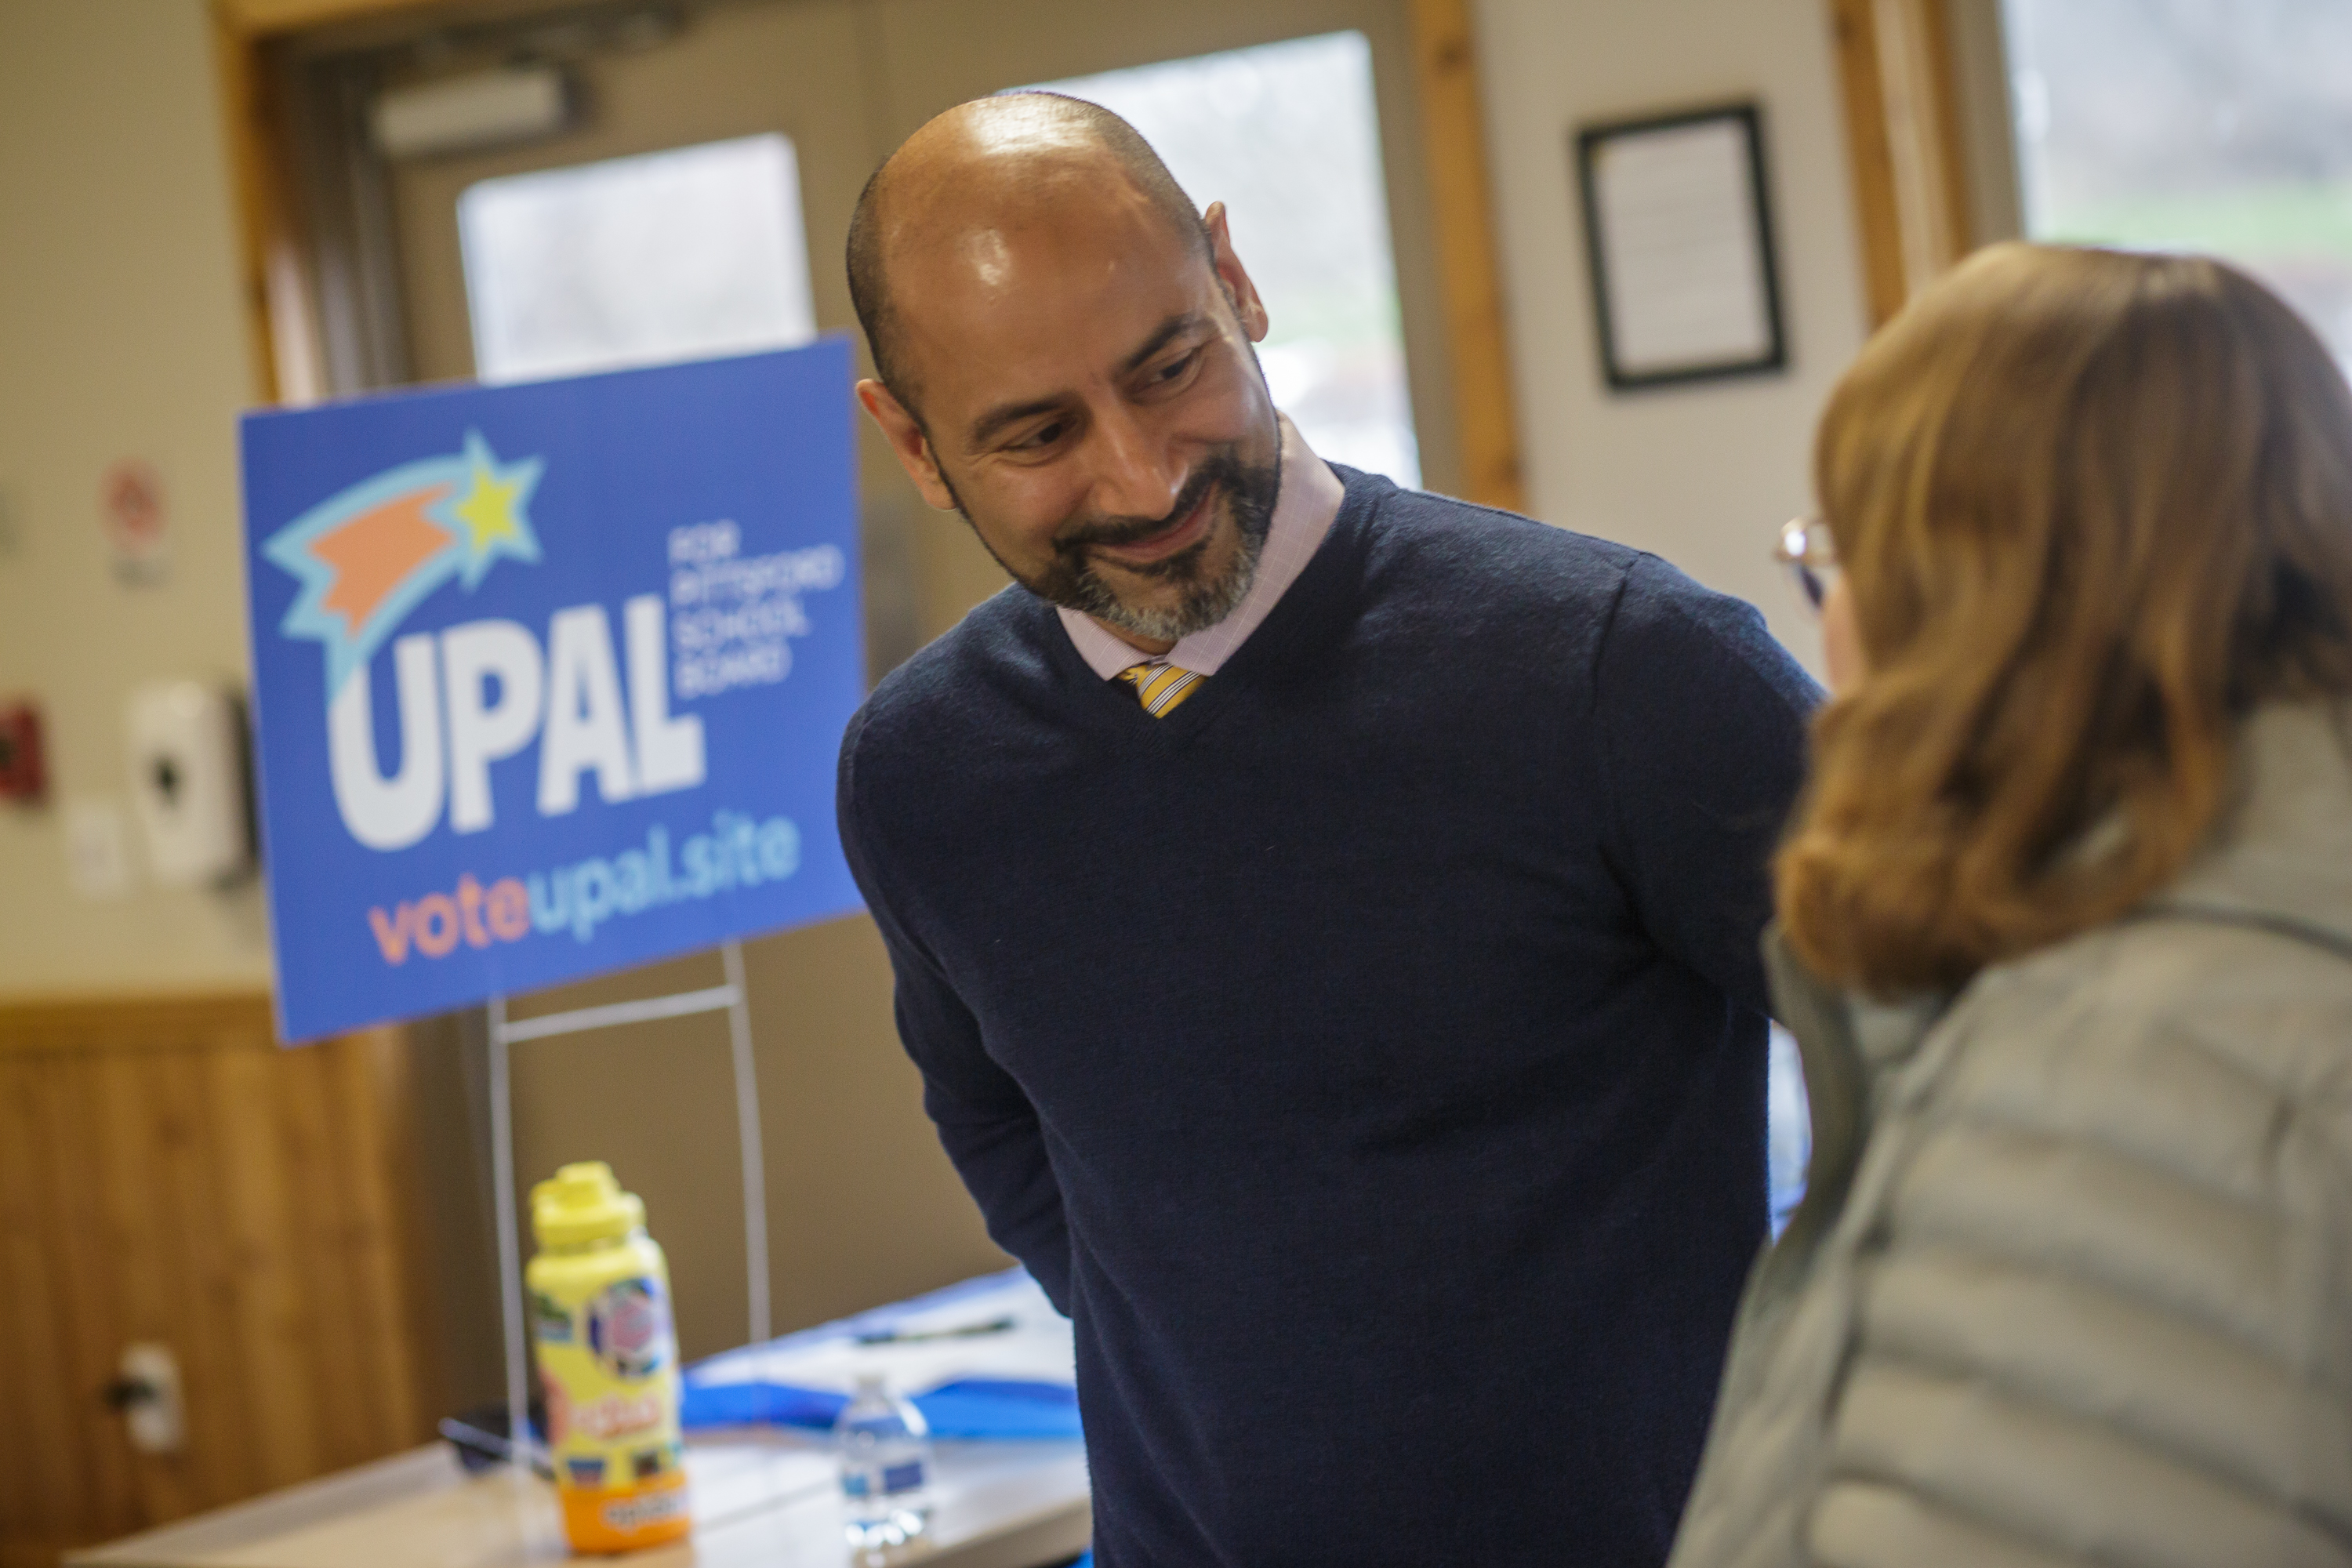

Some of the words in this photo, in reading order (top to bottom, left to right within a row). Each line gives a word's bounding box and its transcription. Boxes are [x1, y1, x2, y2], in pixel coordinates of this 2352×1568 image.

[671, 522, 740, 564] FOR
[674, 596, 808, 649] SCHOOL
[677, 642, 790, 697] BOARD
[328, 595, 705, 851] UPAL
[369, 811, 800, 966] voteupal.site
